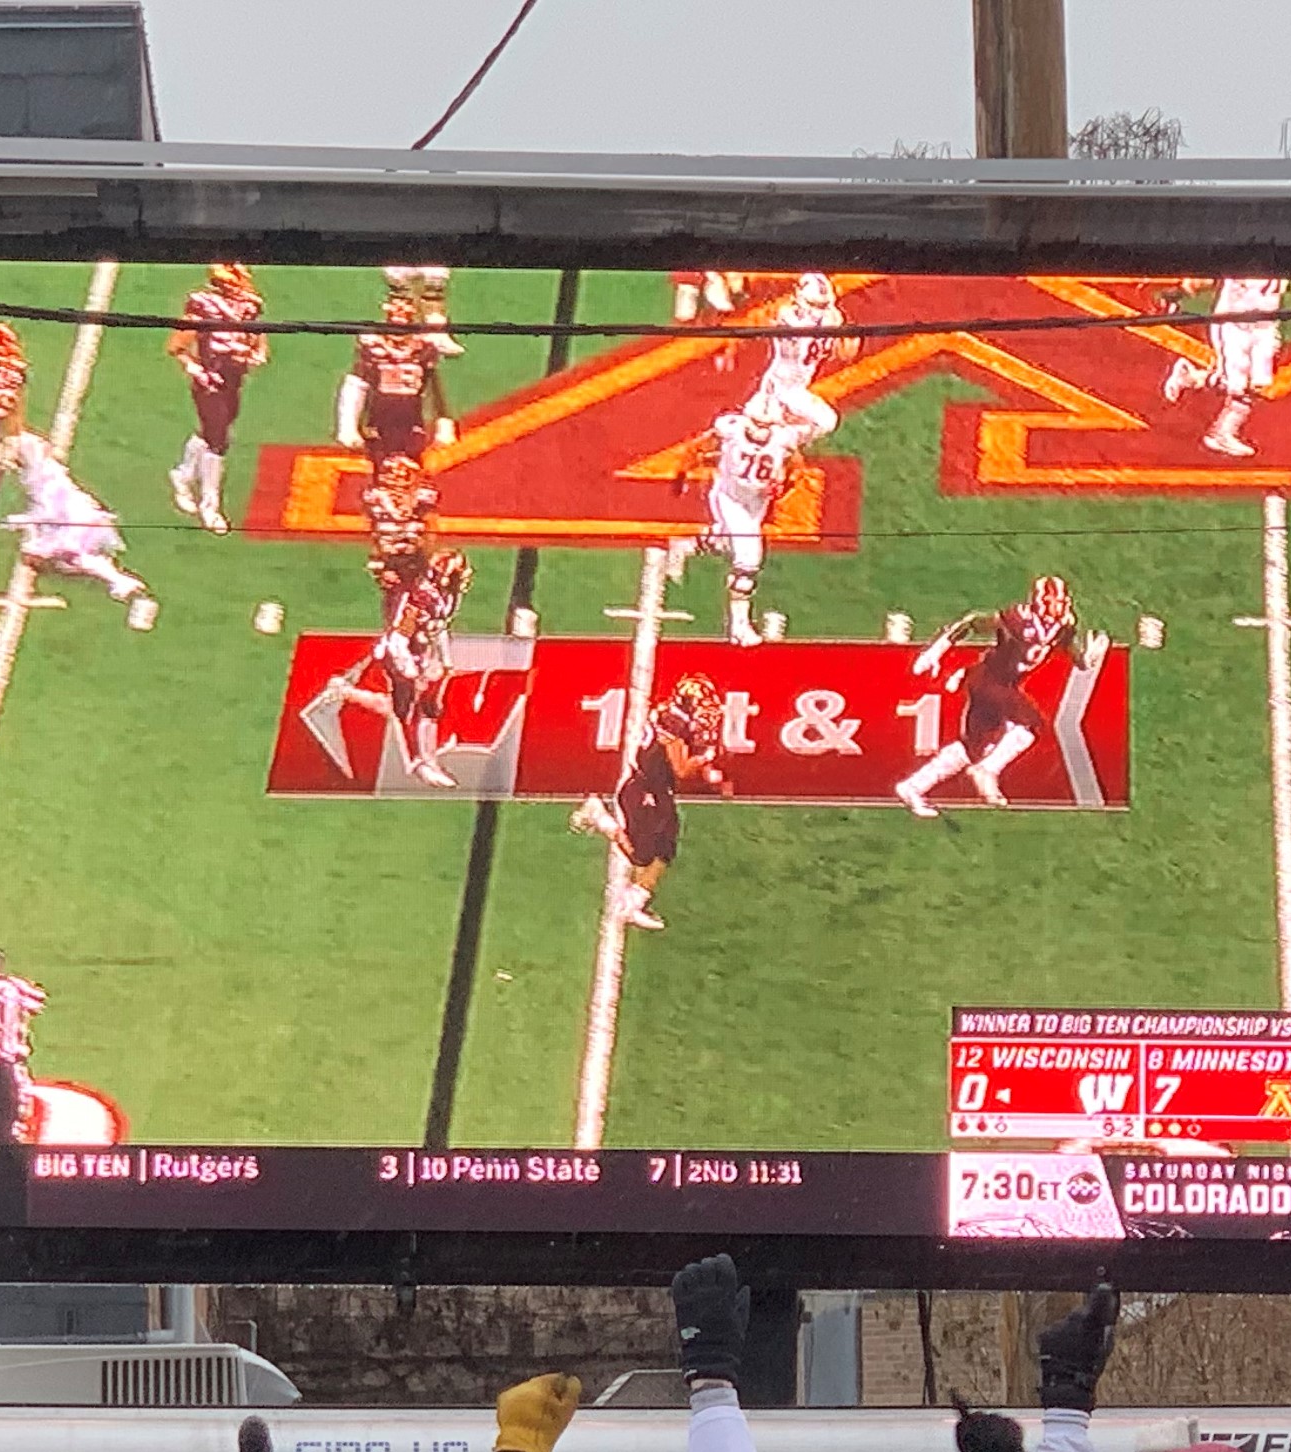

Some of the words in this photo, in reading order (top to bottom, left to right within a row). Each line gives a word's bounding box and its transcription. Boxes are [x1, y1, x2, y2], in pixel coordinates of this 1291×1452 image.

[581, 688, 759, 753] 1t
[780, 689, 863, 756] &
[961, 1014, 1031, 1034] WINNER
[1035, 1015, 1058, 1034] TO
[1060, 1015, 1092, 1034] BIG
[1095, 1016, 1131, 1035] TEN
[1132, 1016, 1268, 1038] CHAMPIONSHIP
[956, 1047, 984, 1068] 12
[991, 1047, 1132, 1070] WISCONSIN
[958, 1074, 988, 1111] 0
[1153, 1075, 1182, 1113] 7
[1103, 1122, 1135, 1138] 9-2
[35, 1154, 78, 1178] BIG
[82, 1155, 130, 1178] TEN
[154, 1154, 260, 1183] Rutgers
[380, 1156, 399, 1180] 3
[420, 1157, 448, 1180] 10
[453, 1156, 520, 1180] Penn
[526, 1157, 601, 1182] State
[649, 1158, 667, 1184] 7
[688, 1160, 739, 1184] 2ND
[750, 1160, 802, 1184] 11:31
[1125, 1163, 1236, 1180] SATURDAY
[962, 1172, 1034, 1201] 7:30
